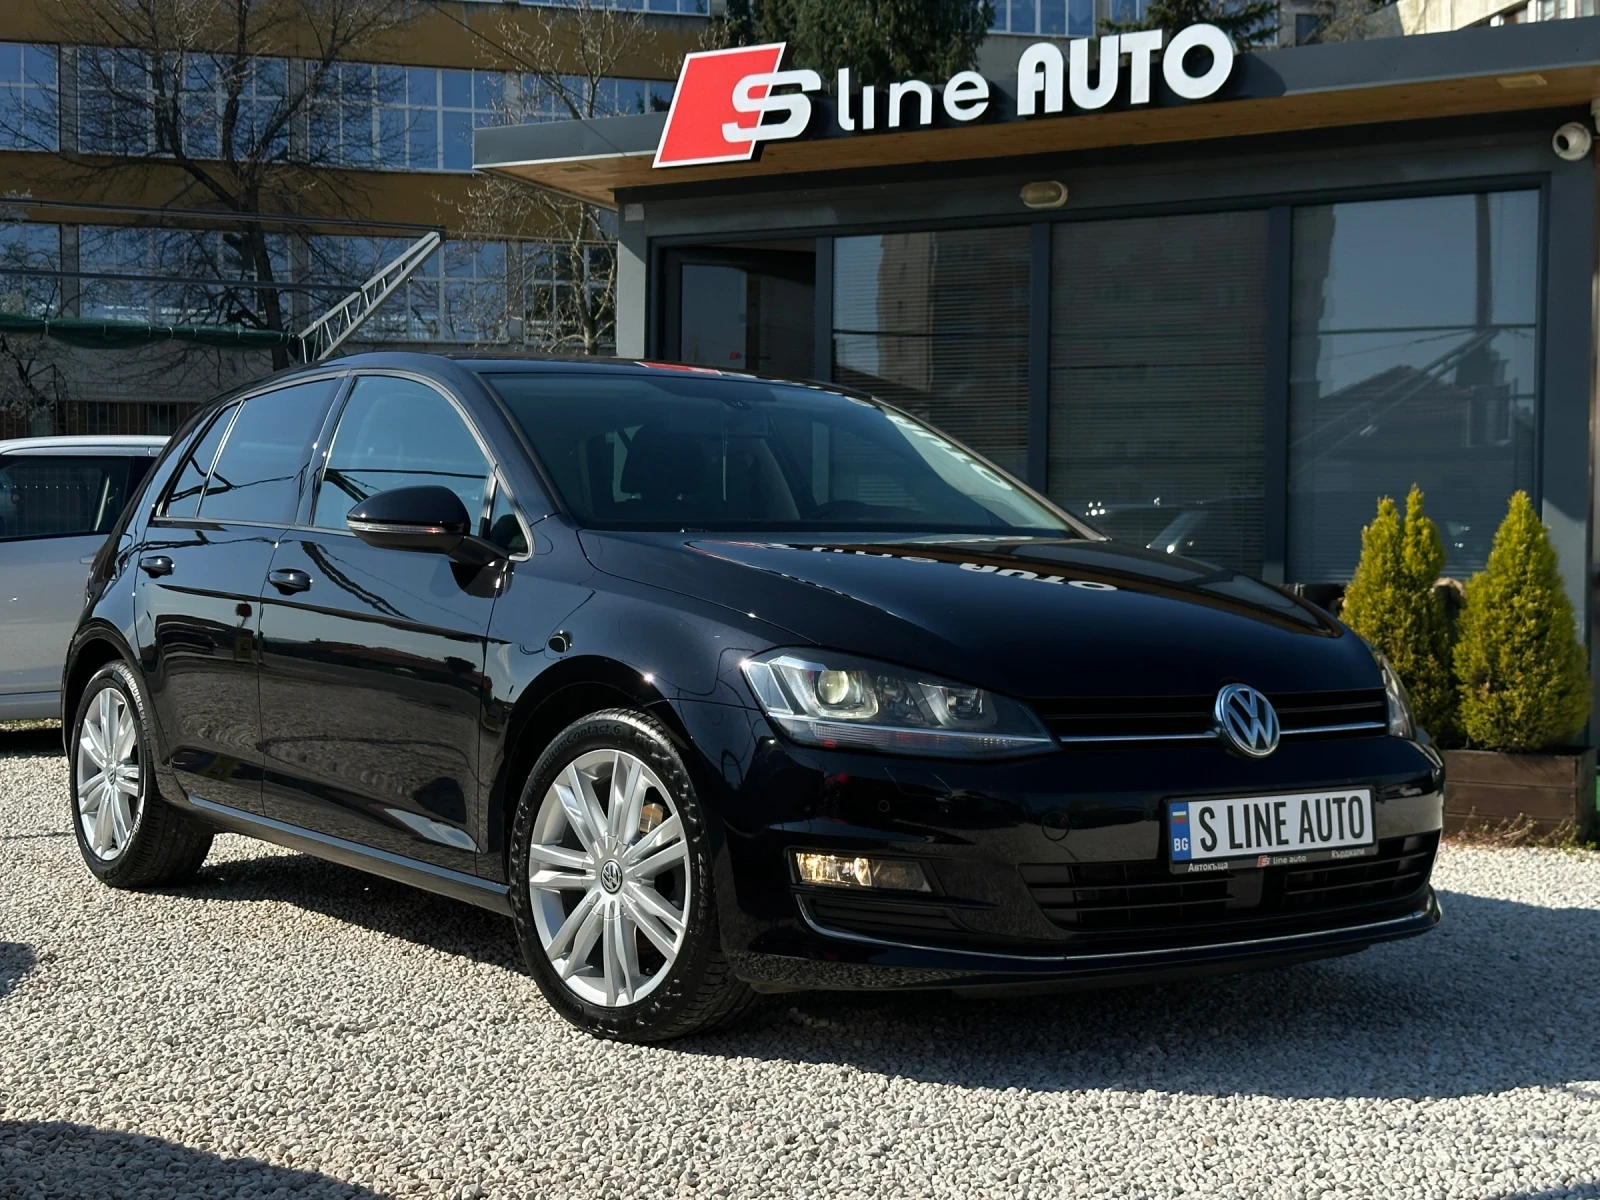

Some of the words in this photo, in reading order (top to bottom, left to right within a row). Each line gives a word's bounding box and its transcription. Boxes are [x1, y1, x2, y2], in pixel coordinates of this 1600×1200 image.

[721, 68, 821, 143] S
[837, 67, 990, 131] line
[1017, 23, 1234, 116] AUTO
[613, 724, 622, 736] 6
[1199, 806, 1217, 852] S
[1226, 801, 1289, 849] LINE
[1299, 795, 1365, 844] AUTO
[1173, 837, 1189, 852] BG
[1273, 857, 1288, 865] line
[1289, 855, 1306, 863] auto
[1188, 862, 1228, 872] Автокъща
